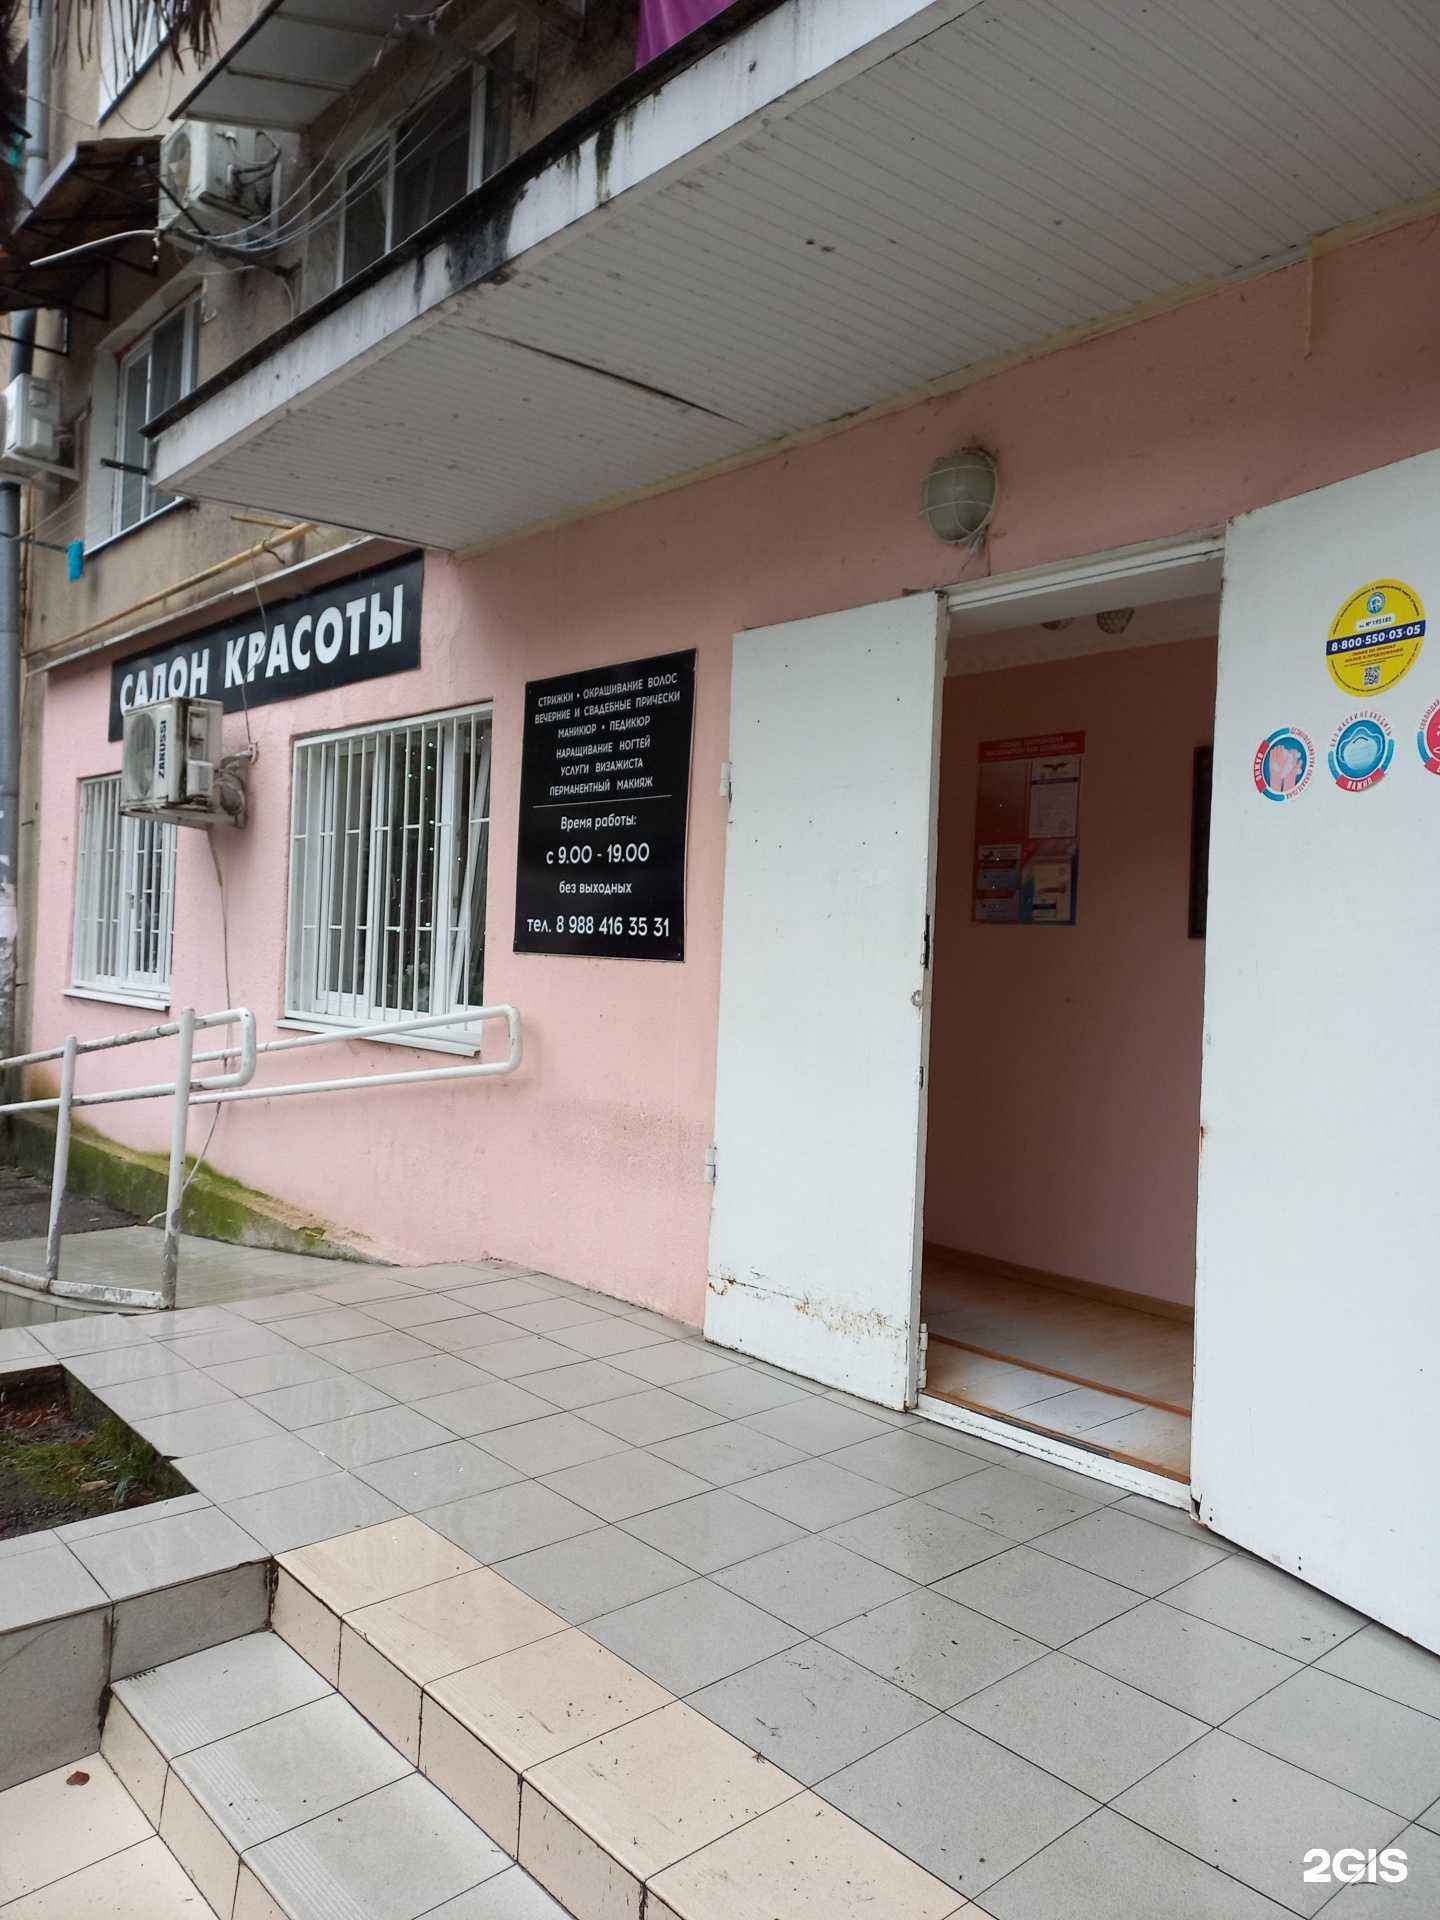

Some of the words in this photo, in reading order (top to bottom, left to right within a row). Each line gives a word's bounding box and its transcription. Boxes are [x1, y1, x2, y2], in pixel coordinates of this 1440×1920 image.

[120, 648, 210, 715] САЛОН
[224, 584, 404, 689] КРАСОТЫ
[538, 692, 574, 708] СТРИЖКИ
[583, 678, 644, 699] ОКРАШИВАНИЕ
[647, 672, 678, 689] ВОЛОС
[535, 709, 571, 724] ВЕЧЕРНИЕ
[574, 708, 580, 718] И
[584, 700, 632, 716] СВАДЕБНЫЕ
[635, 690, 681, 707] ПРИЧЕСКИ
[558, 723, 597, 739] МАНИКЮР
[609, 715, 651, 731] ПЕДИКЮР
[158, 719, 167, 779] ZANUSSI
[556, 741, 613, 759] НАРАЩИВАНИЕ
[619, 734, 651, 751] НОГТЕЙ
[560, 763, 589, 776] УСЛУГИ
[595, 757, 643, 773] ВИЗАЖИСТА
[549, 778, 611, 796] ПЕРМАНЕНТНЫЙ
[616, 776, 653, 790] МАКИЯЖ
[1346, 777, 1374, 791] ВАЖНО
[560, 815, 592, 832] Время
[594, 813, 637, 830] работы:
[546, 851, 554, 864] с
[557, 845, 592, 864] 9.00
[606, 842, 650, 863] 19.00
[559, 880, 576, 894] без
[579, 882, 632, 895] выходных
[526, 918, 552, 933] тел.
[556, 915, 565, 933] 8
[568, 915, 594, 934] 988
[599, 916, 623, 936] 416
[628, 917, 648, 936] 35
[653, 917, 670, 937] 31
